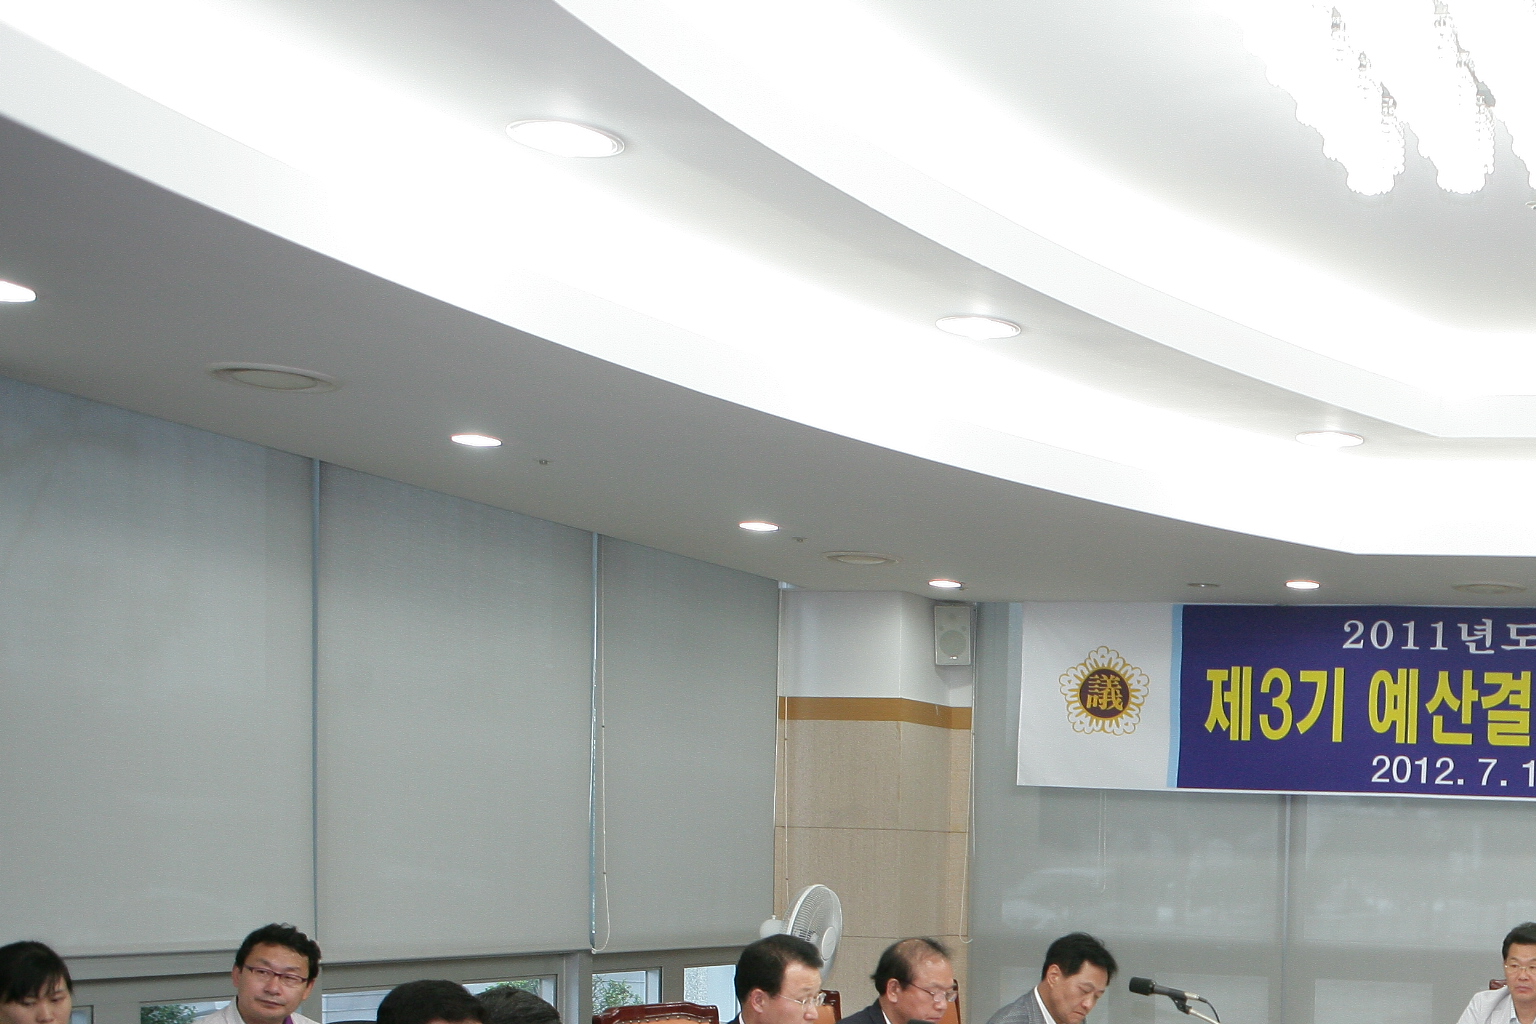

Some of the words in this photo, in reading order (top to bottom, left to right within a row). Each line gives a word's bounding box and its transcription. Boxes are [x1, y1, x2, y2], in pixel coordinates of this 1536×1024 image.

[1204, 665, 1346, 743] 제3기
[1371, 755, 1465, 786] 2012.
[1478, 759, 1508, 787] 7.
